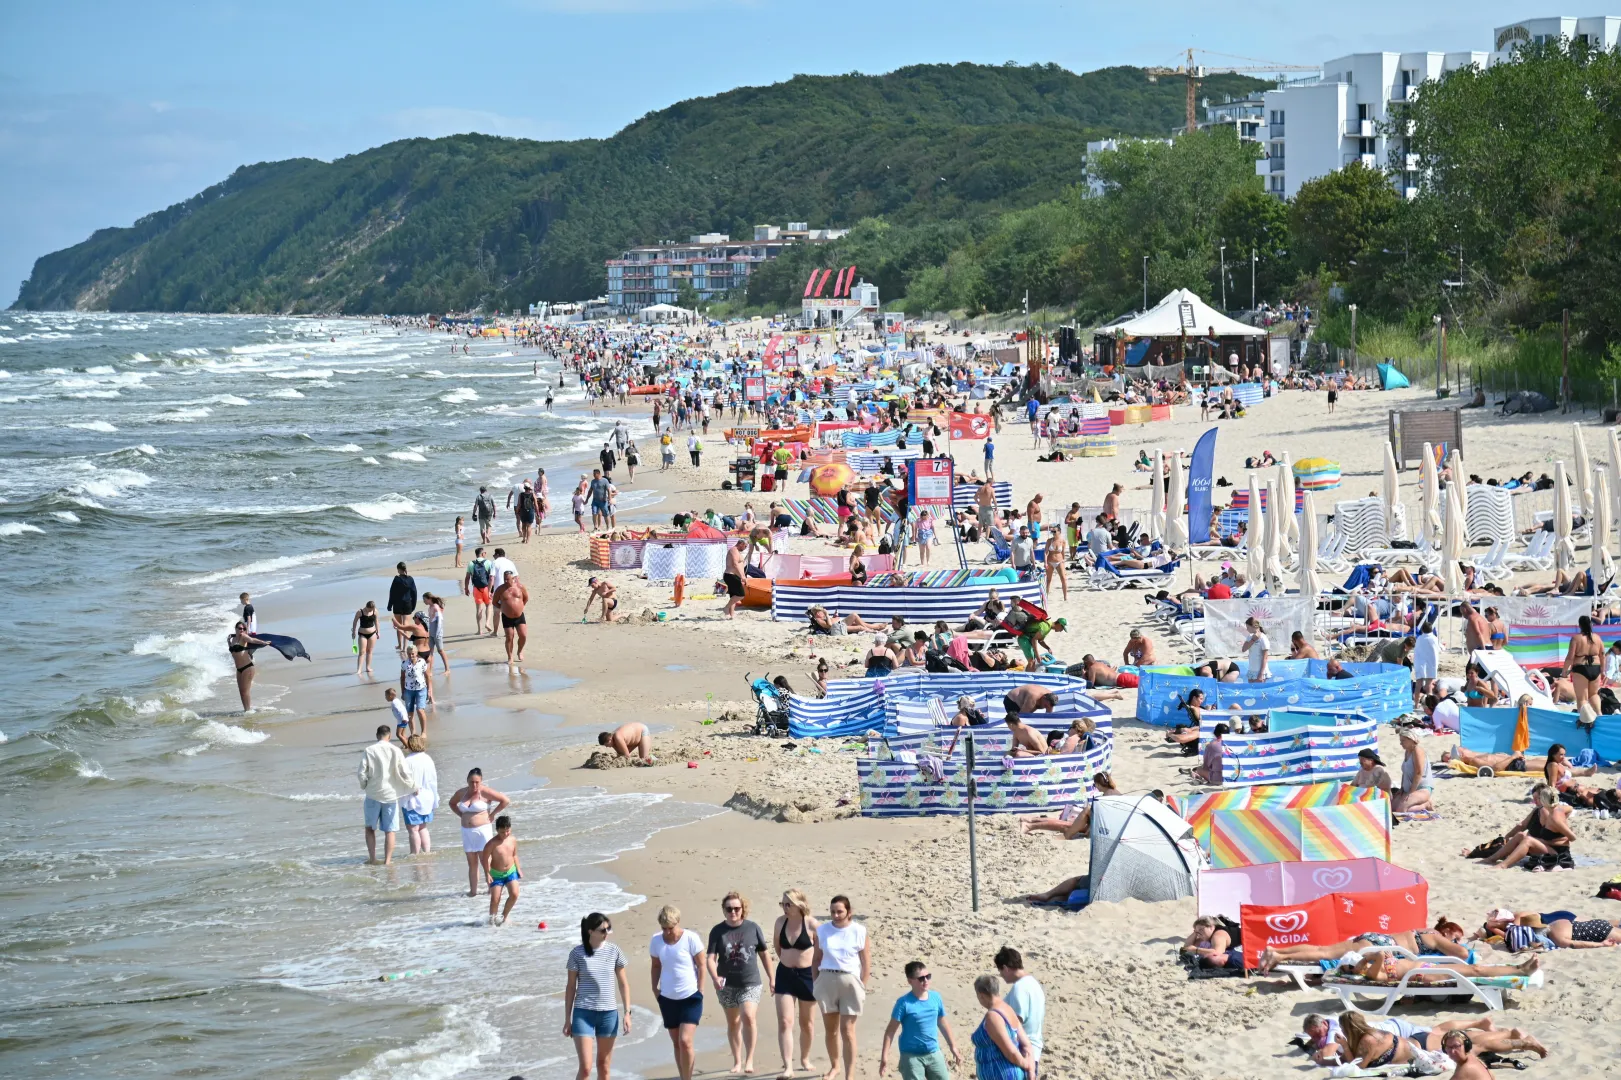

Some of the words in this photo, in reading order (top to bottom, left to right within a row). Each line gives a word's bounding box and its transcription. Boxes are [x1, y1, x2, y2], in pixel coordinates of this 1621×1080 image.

[934, 461, 941, 472] 7
[1192, 477, 1211, 487] 1664
[1266, 934, 1309, 945] ALGIDA
